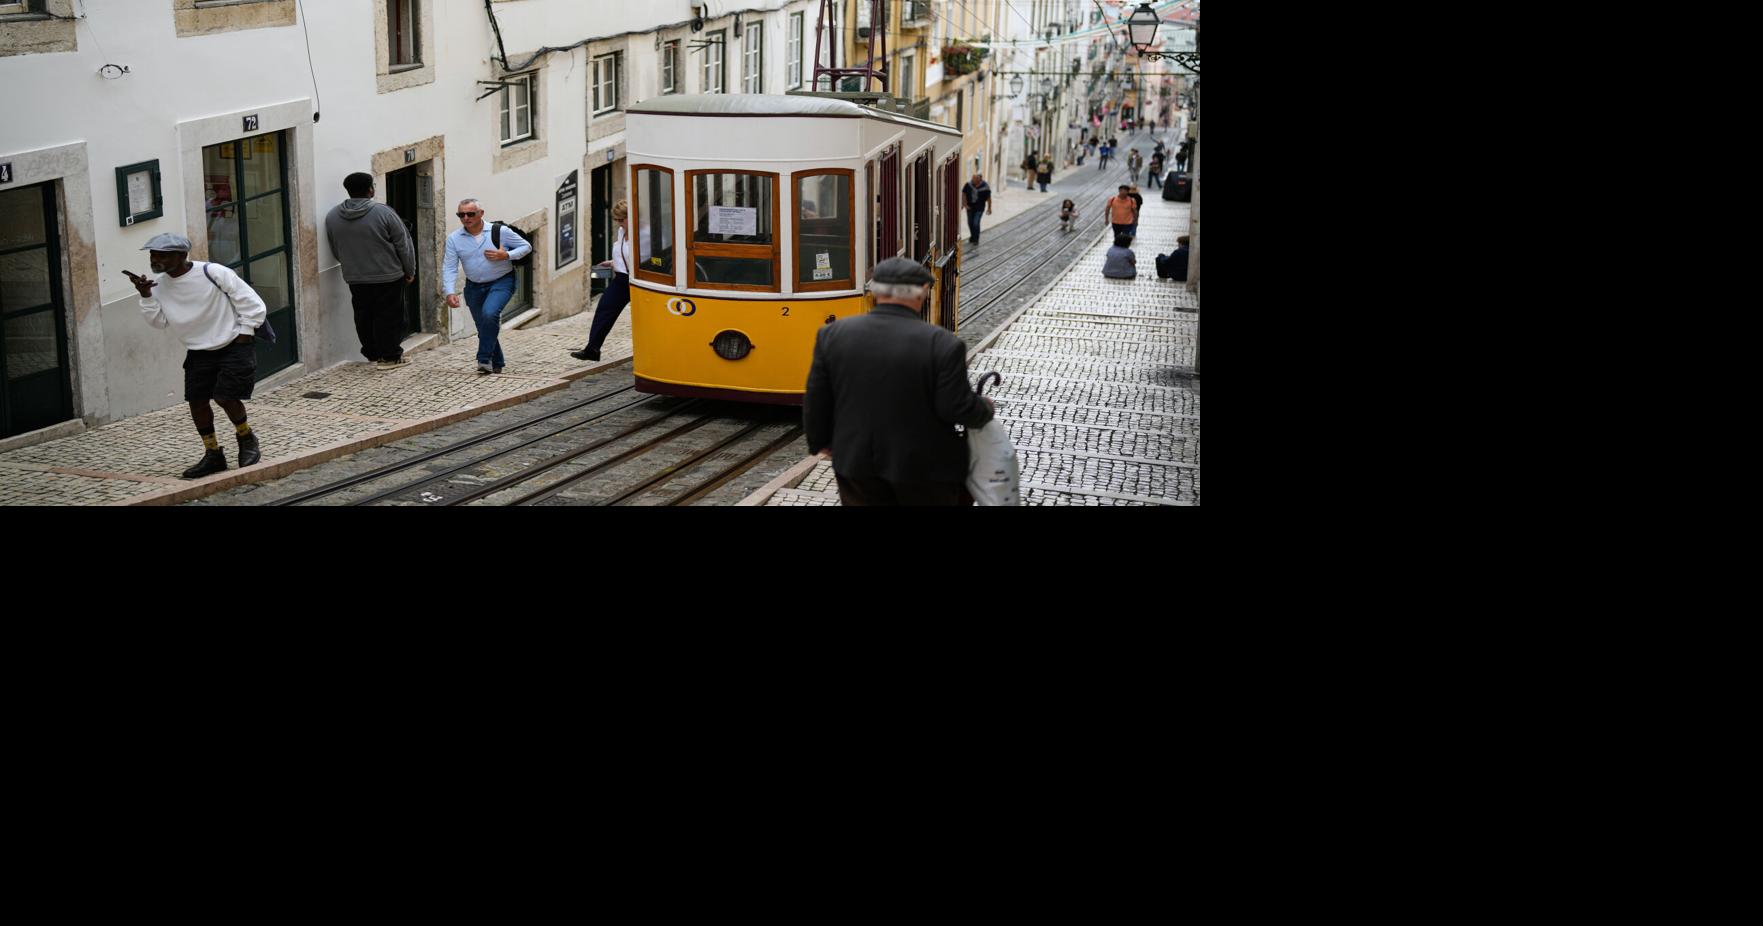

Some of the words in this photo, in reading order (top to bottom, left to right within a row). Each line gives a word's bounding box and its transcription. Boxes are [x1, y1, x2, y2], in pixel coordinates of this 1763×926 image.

[246, 116, 257, 130] 72
[561, 201, 574, 211] ATM
[781, 306, 790, 316] 2
